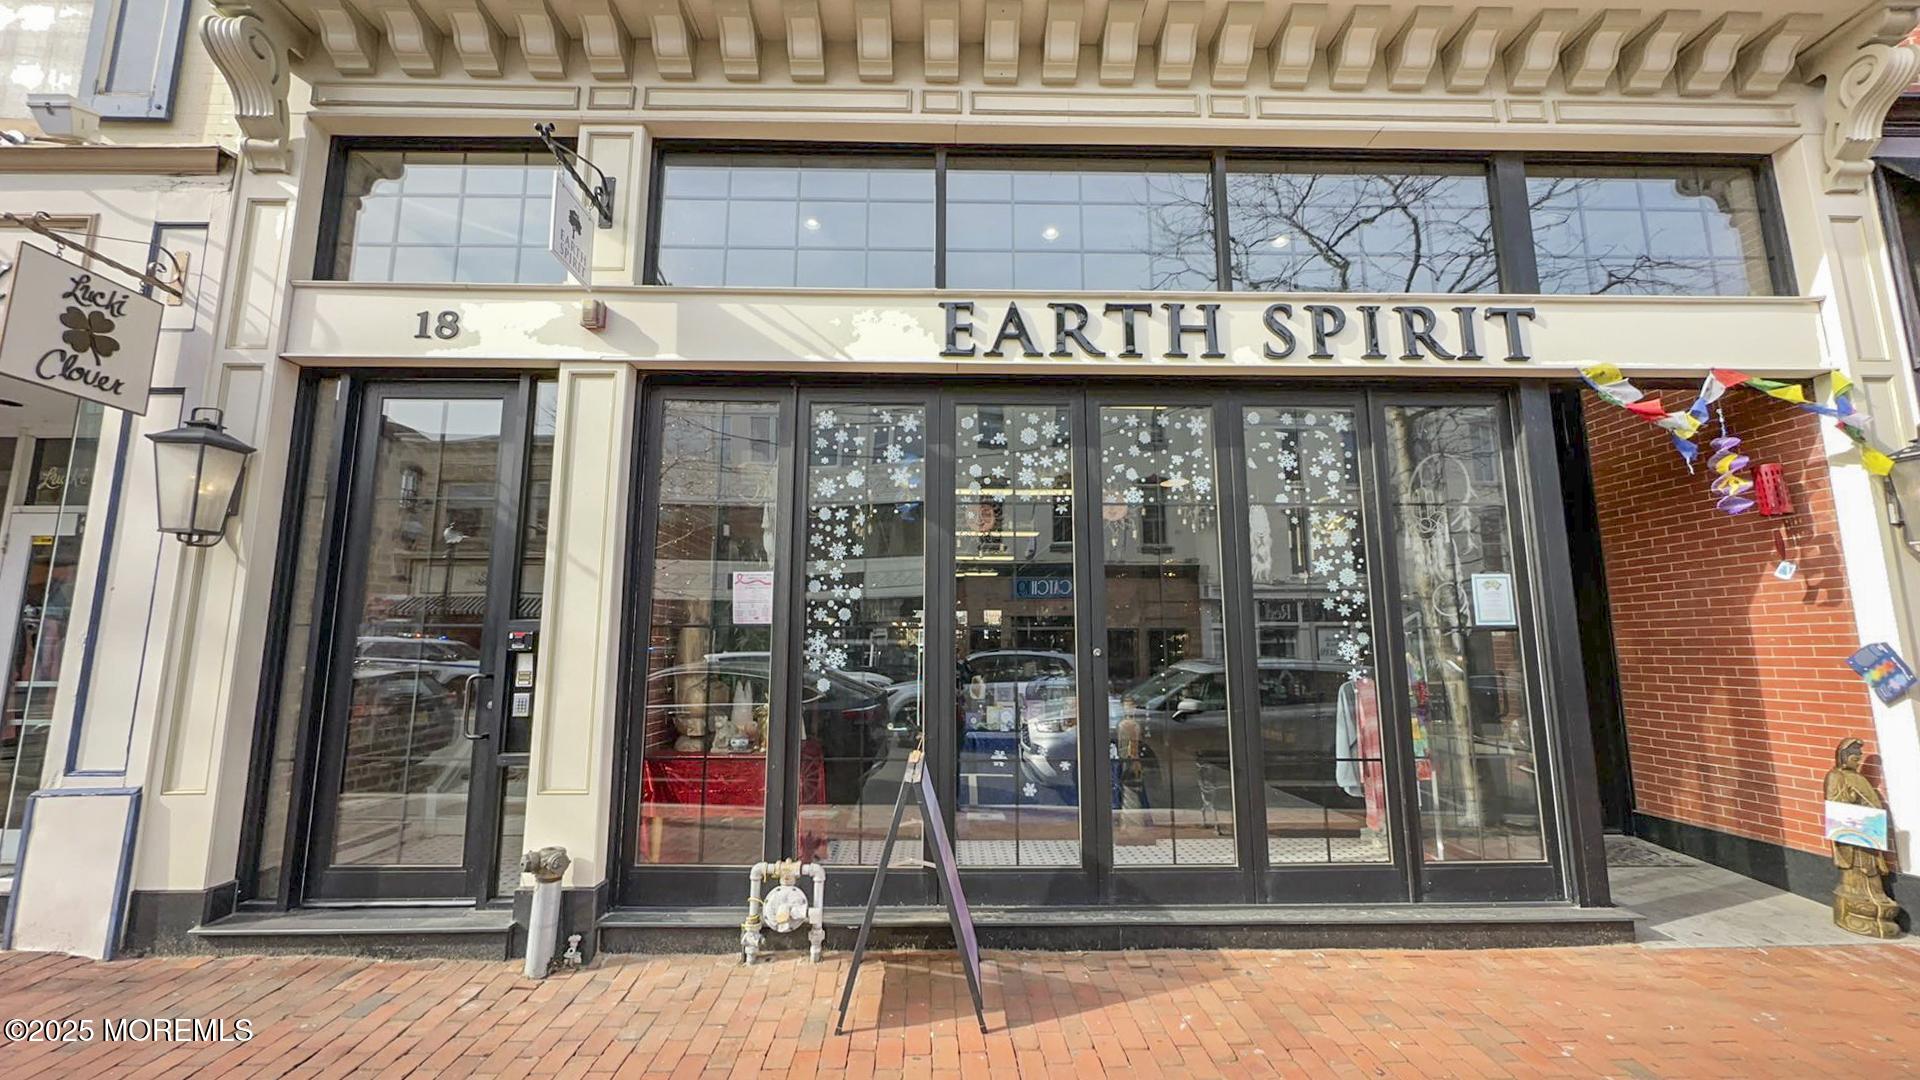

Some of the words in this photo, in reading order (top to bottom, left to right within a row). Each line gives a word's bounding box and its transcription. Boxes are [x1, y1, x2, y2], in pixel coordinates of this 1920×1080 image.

[560, 228, 587, 267] EARTH
[560, 241, 586, 278] SPIRIT
[62, 274, 130, 318] Lucki
[414, 310, 460, 340] 18
[938, 301, 1226, 358] EARTH
[1263, 304, 1536, 362] SPIRIT
[36, 348, 126, 396] Clover
